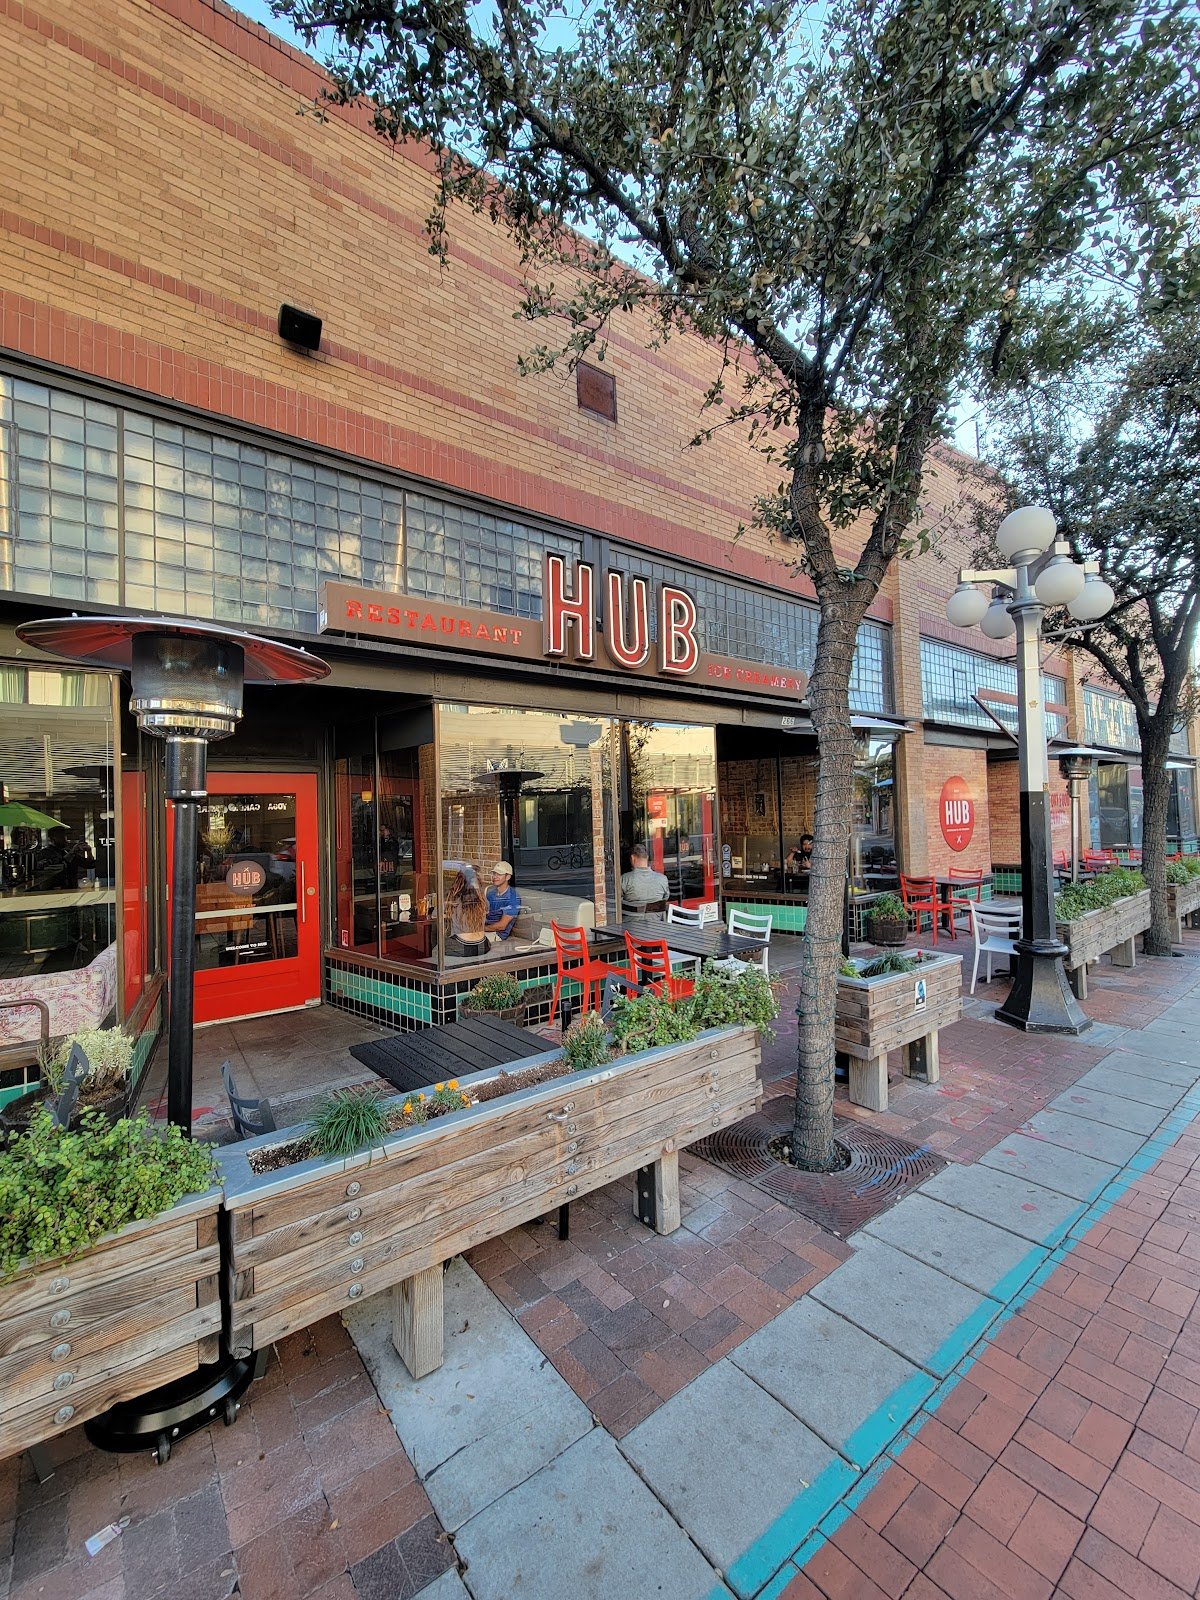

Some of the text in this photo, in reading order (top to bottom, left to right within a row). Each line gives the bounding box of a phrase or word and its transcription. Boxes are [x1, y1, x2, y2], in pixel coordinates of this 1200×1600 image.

[346, 600, 522, 645] RESTAURANT
[543, 551, 700, 676] HUB
[708, 664, 802, 690] ICE CREAMERY
[945, 800, 970, 825] HUB
[232, 871, 261, 886] HUB
